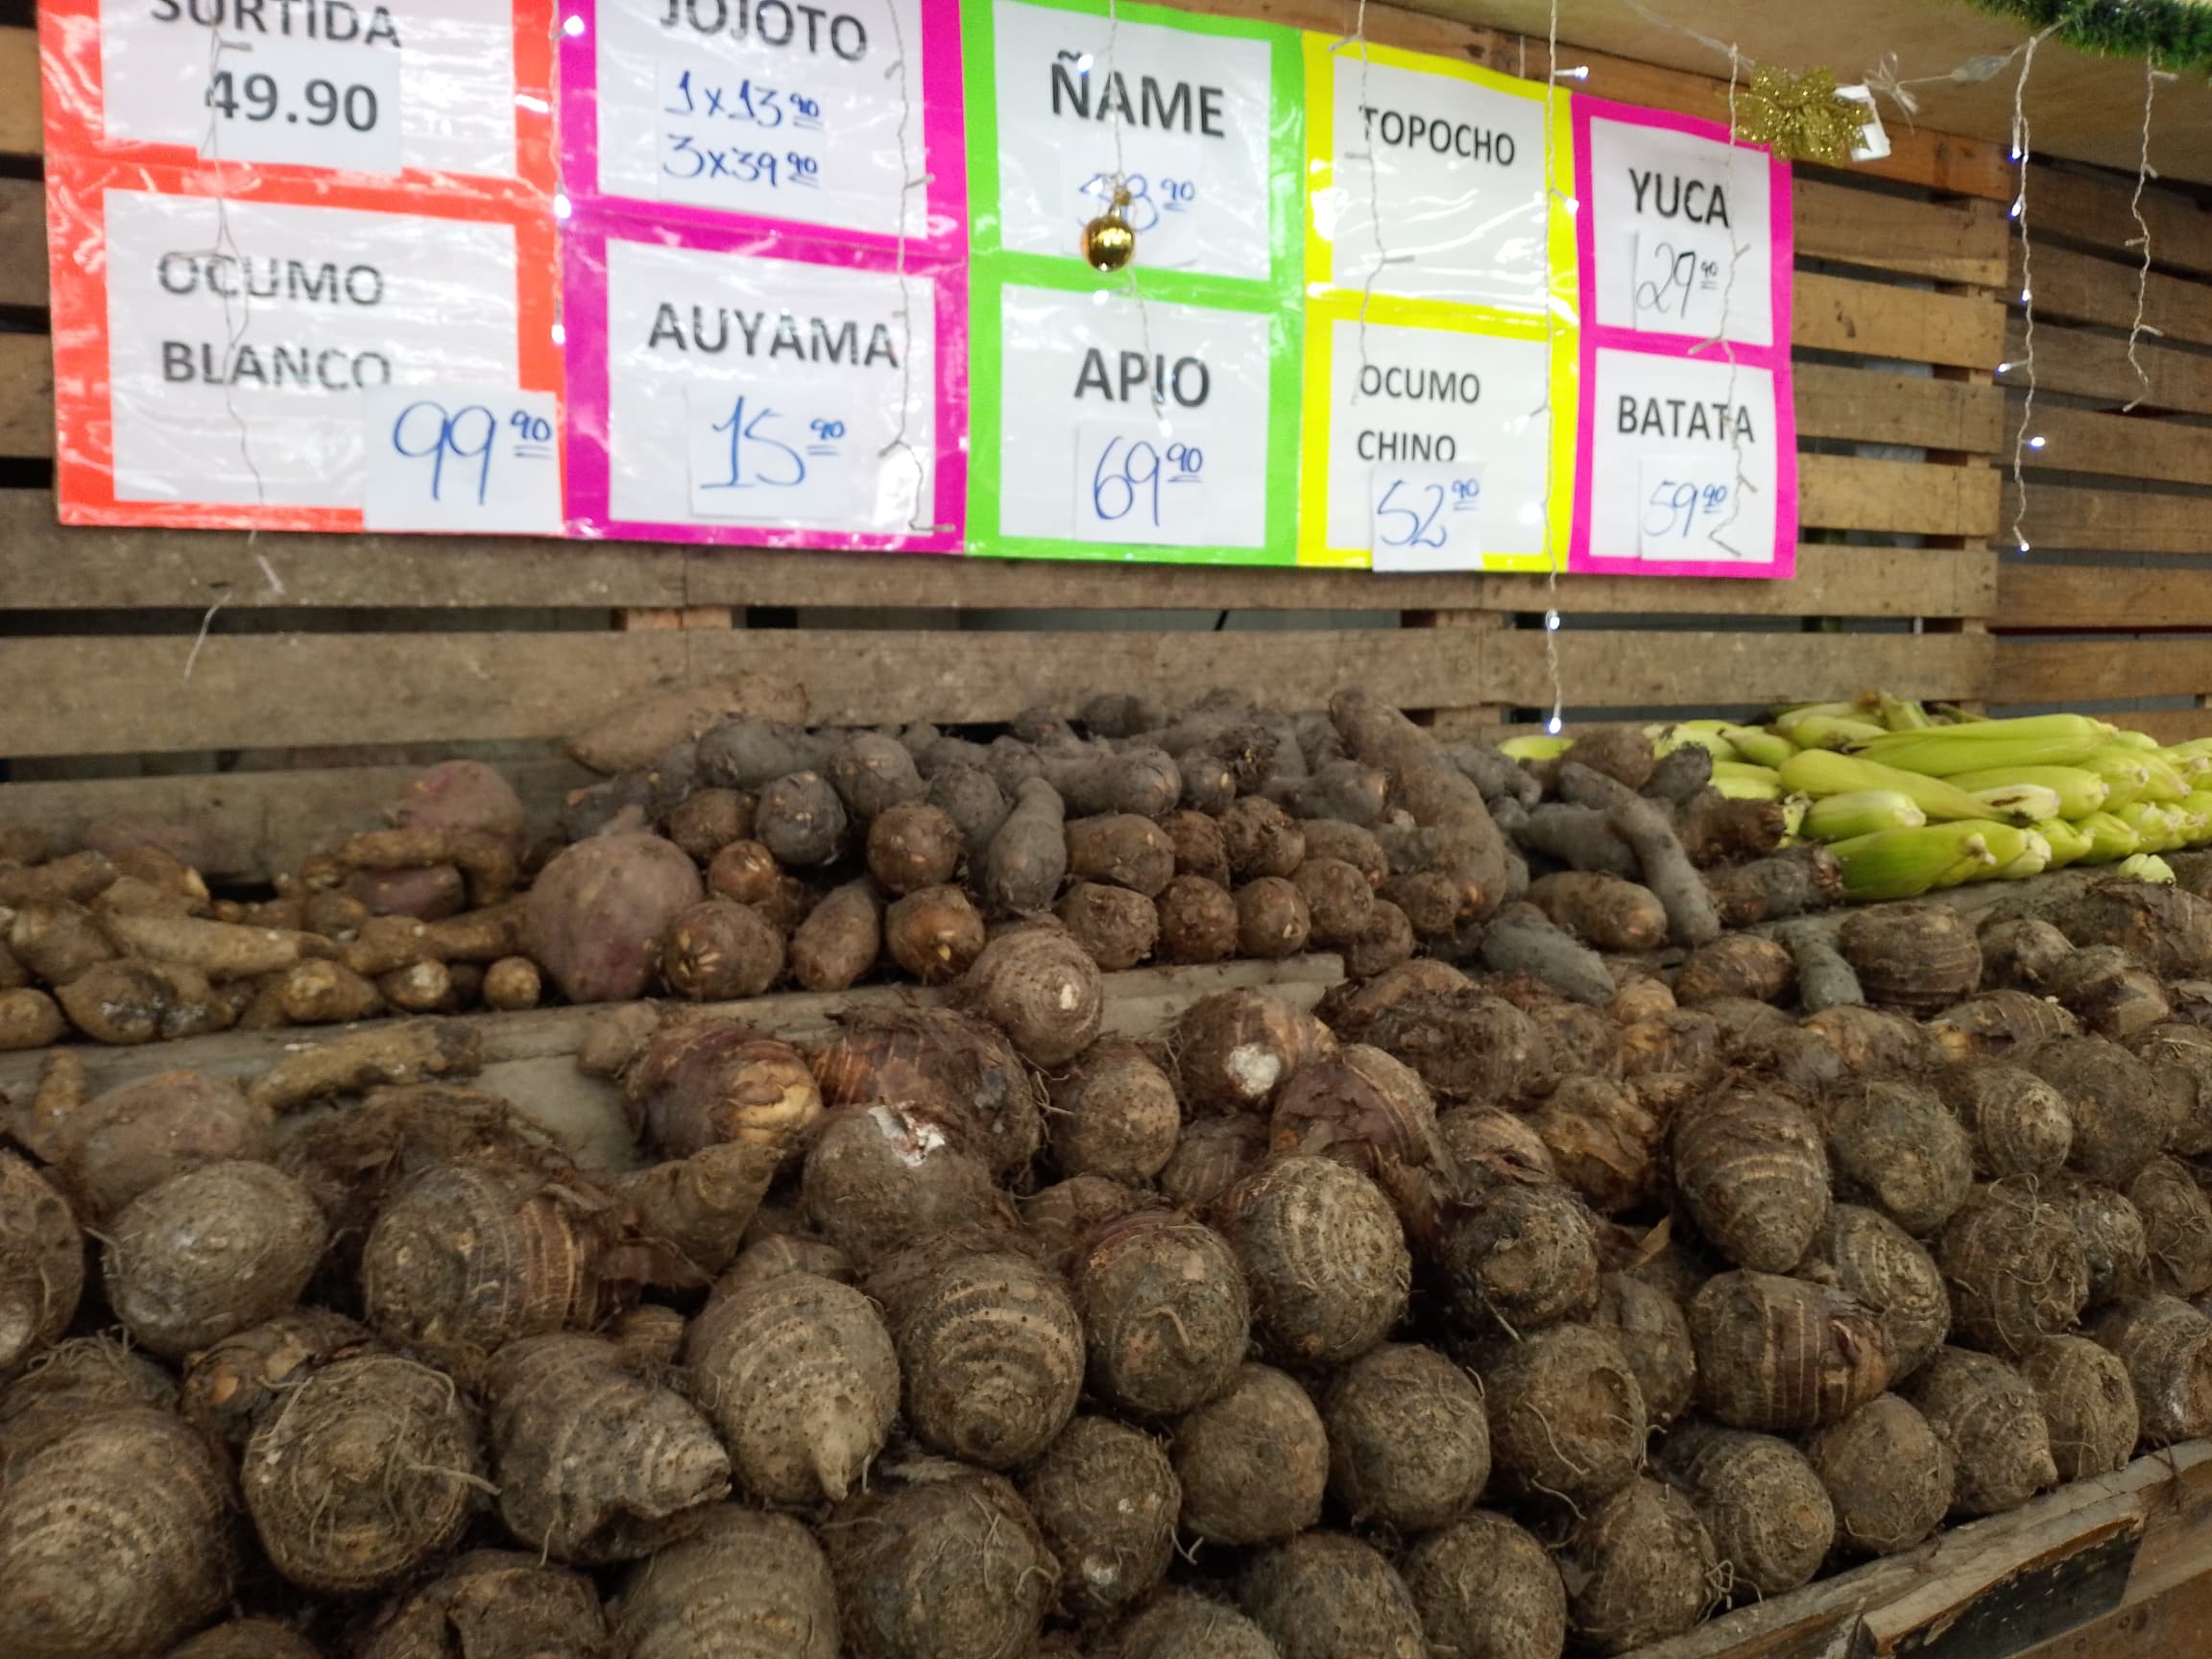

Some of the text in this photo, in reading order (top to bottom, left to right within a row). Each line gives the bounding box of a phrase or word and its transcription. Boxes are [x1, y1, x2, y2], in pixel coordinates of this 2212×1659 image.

[152, 0, 401, 48] SURTIDA
[204, 70, 378, 132] 49.90
[1050, 50, 1227, 138] ÑAME
[1358, 105, 1515, 167] TOPOCHO
[1628, 167, 1730, 228] YUCA
[157, 252, 385, 306] OCUMO
[649, 302, 900, 369] AUYAMA
[161, 341, 392, 390] BLANCO
[1074, 348, 1211, 408] APIO
[1359, 365, 1480, 403] OCUMO
[1357, 431, 1456, 462] CHINO
[1618, 395, 1755, 444] BATATA
